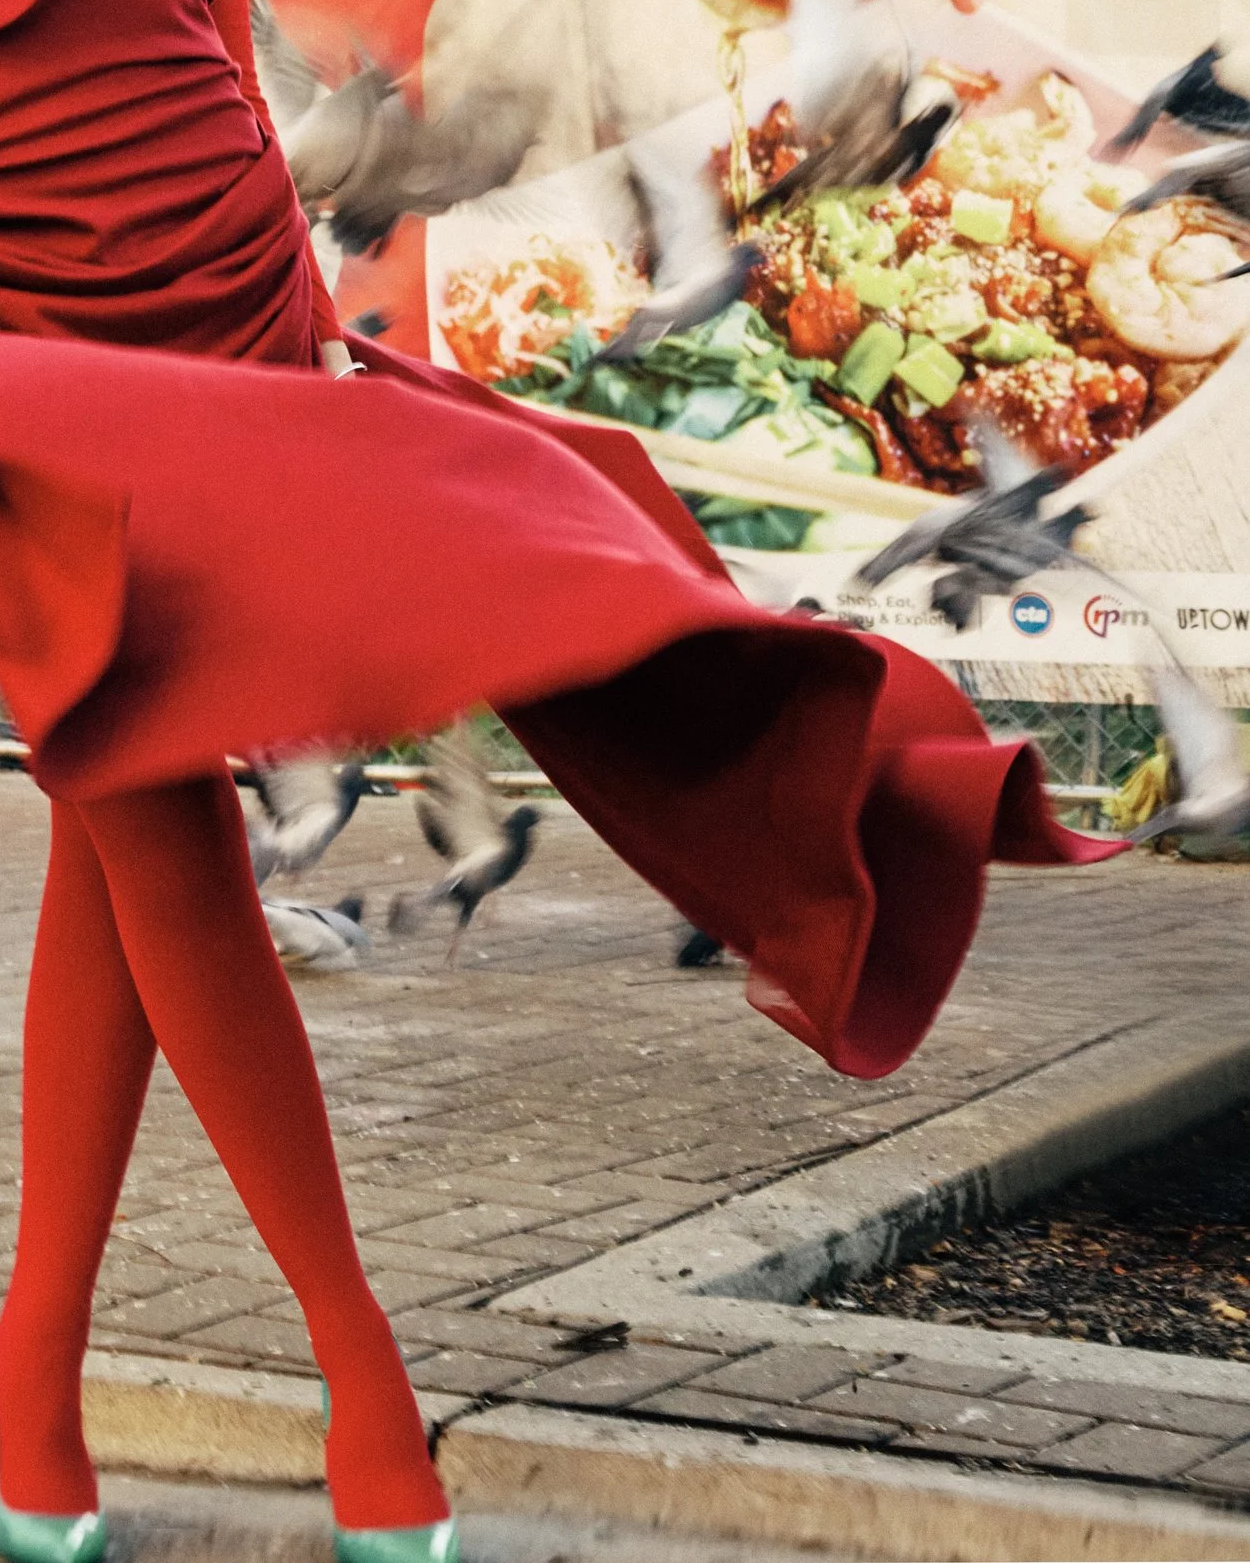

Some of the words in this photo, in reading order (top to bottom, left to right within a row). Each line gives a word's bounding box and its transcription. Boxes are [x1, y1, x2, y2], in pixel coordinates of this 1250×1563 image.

[886, 595, 915, 609] Eat,
[879, 612, 890, 624] &
[894, 611, 947, 627] Explor
[1090, 605, 1150, 638] rpm
